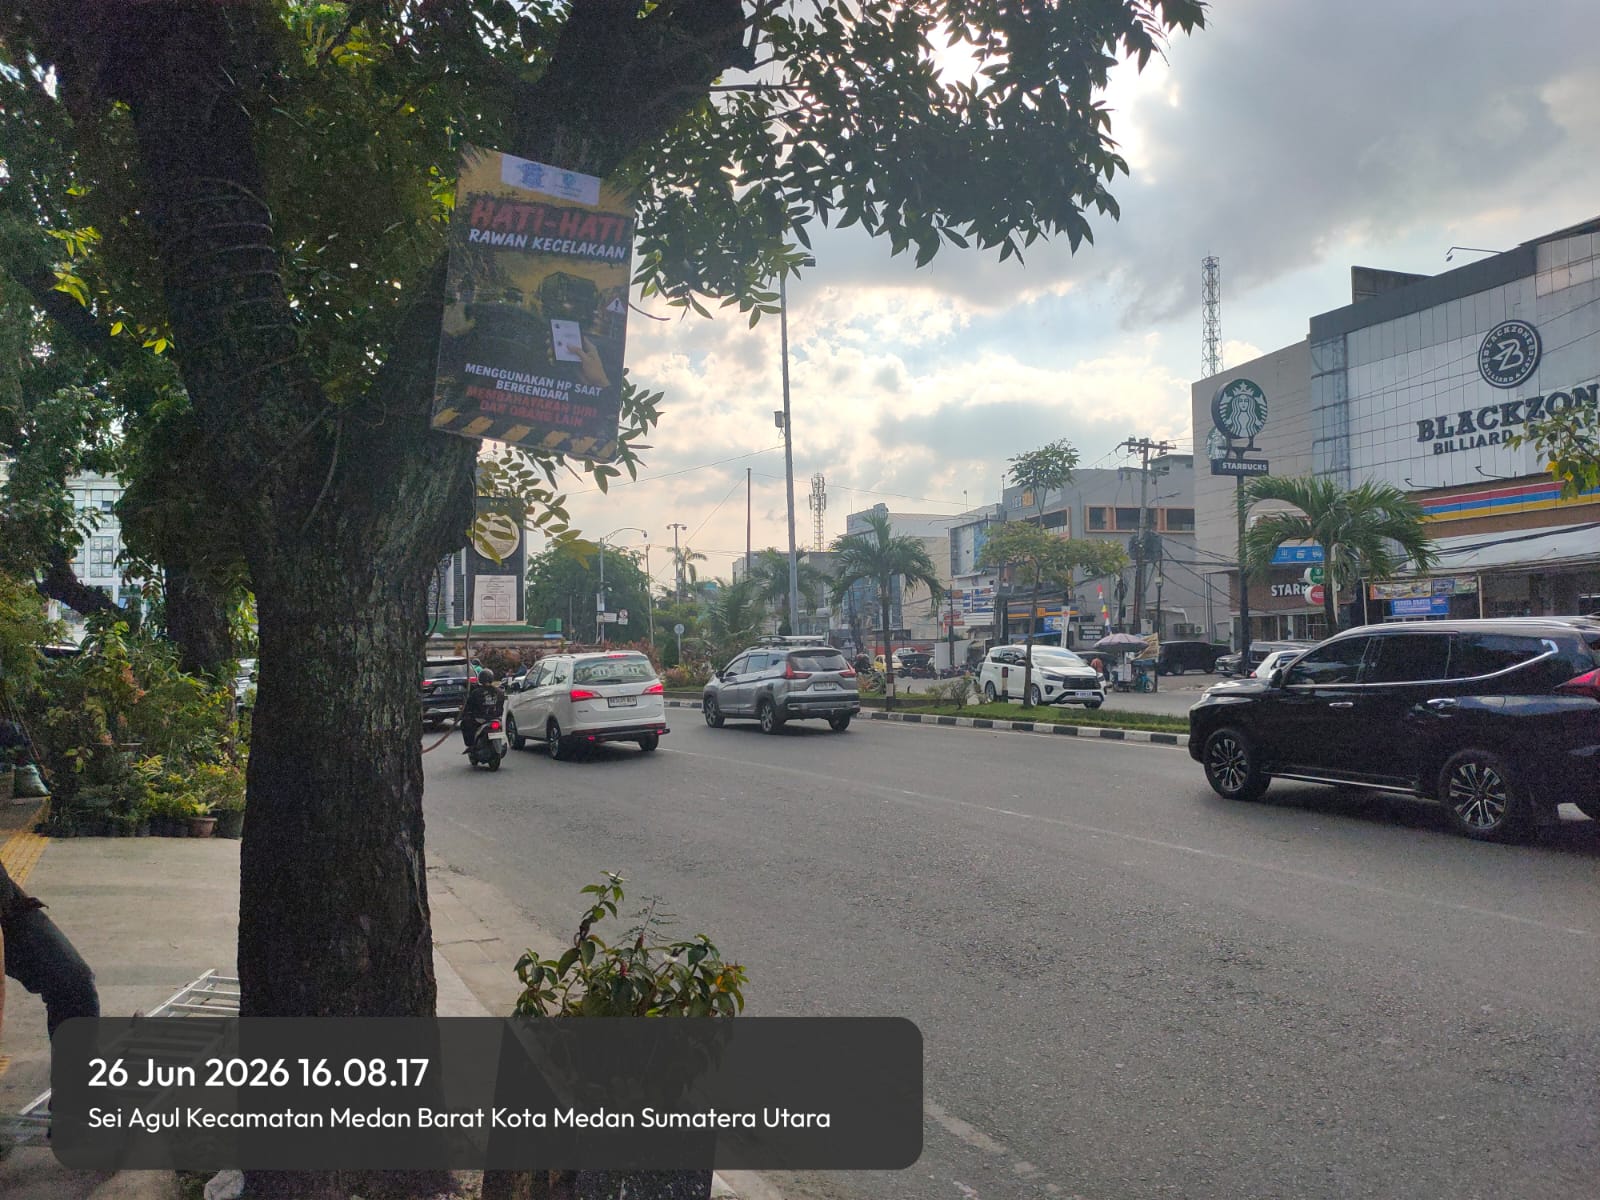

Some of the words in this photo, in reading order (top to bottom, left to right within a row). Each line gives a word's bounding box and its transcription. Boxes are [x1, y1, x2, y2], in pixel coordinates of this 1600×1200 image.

[470, 199, 625, 242] HATI-HATI
[469, 228, 528, 248] RAWAN
[532, 236, 626, 259] KECELAKAAN
[465, 363, 554, 388] MENGGUNAKAN
[557, 380, 573, 391] HP
[575, 384, 602, 396] SAAT
[496, 380, 569, 402] BERKENDARA
[555, 414, 583, 427] LAIN
[1433, 430, 1513, 455] BILLIARD
[1222, 462, 1267, 471] STARBUCKS
